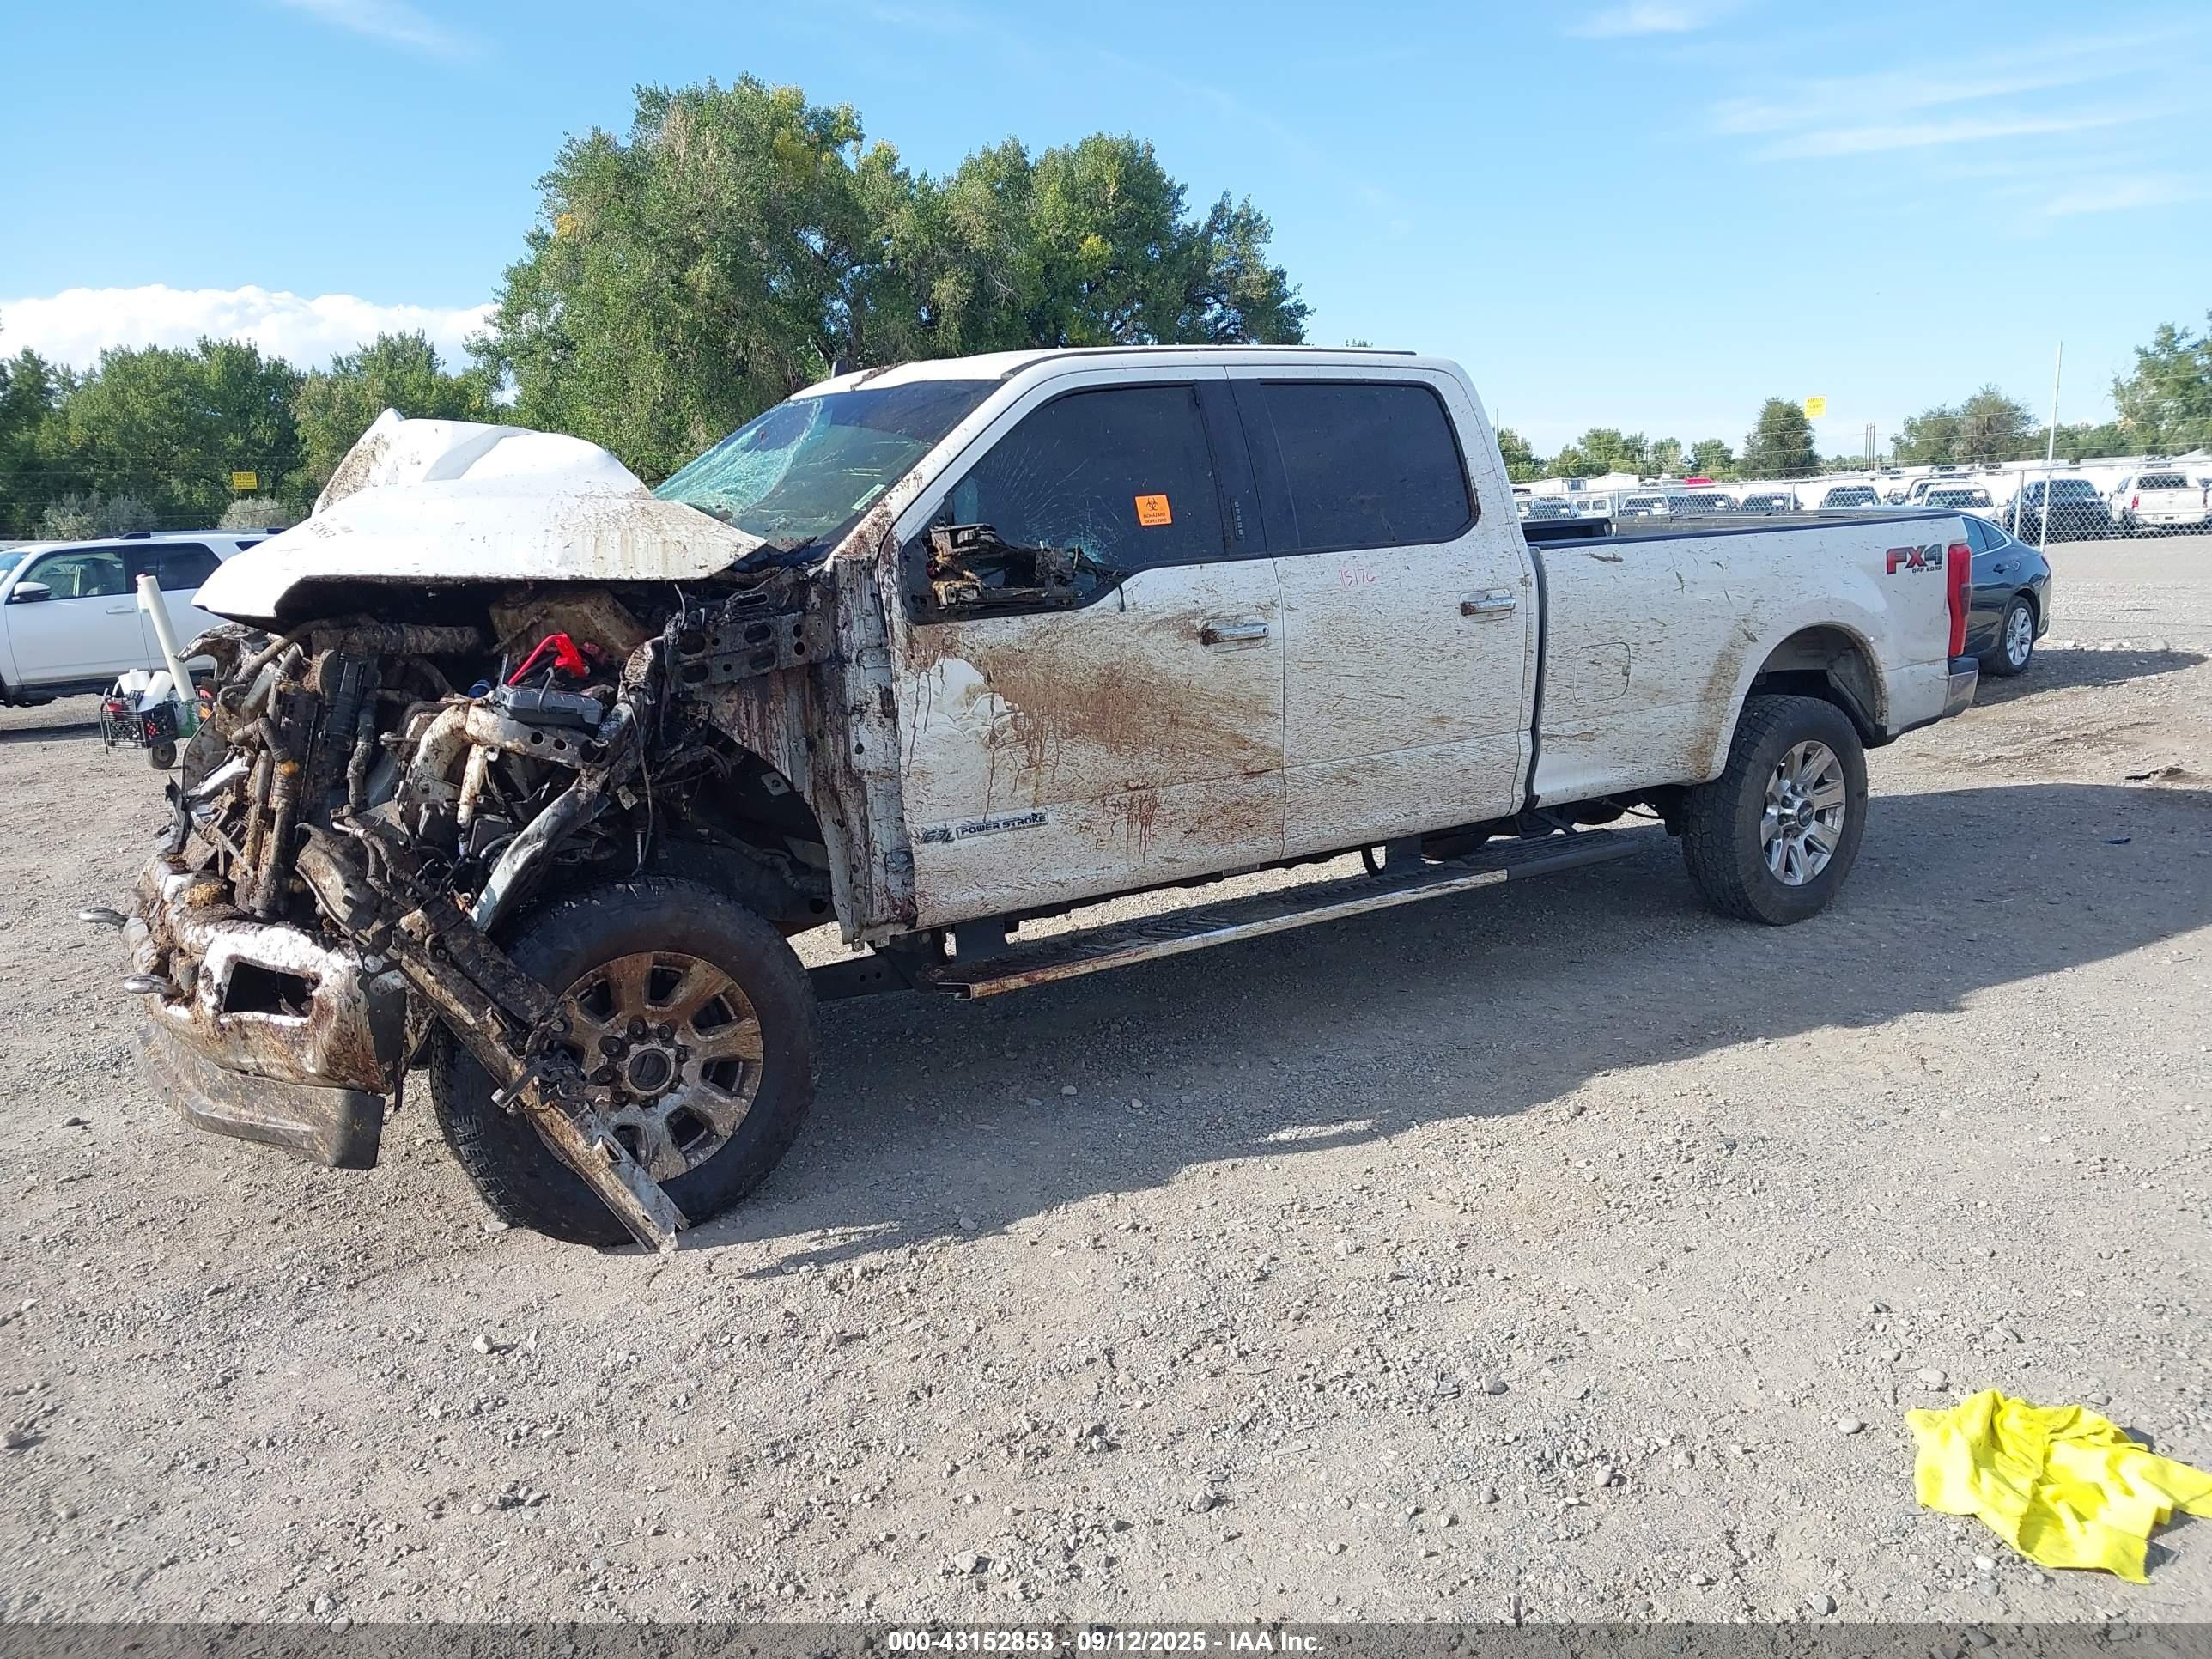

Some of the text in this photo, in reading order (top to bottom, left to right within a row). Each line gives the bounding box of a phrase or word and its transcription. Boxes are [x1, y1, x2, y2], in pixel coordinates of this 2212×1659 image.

[1887, 544, 1943, 574] FX4
[961, 823, 1000, 836] POWER
[1002, 814, 1046, 829] STROKE
